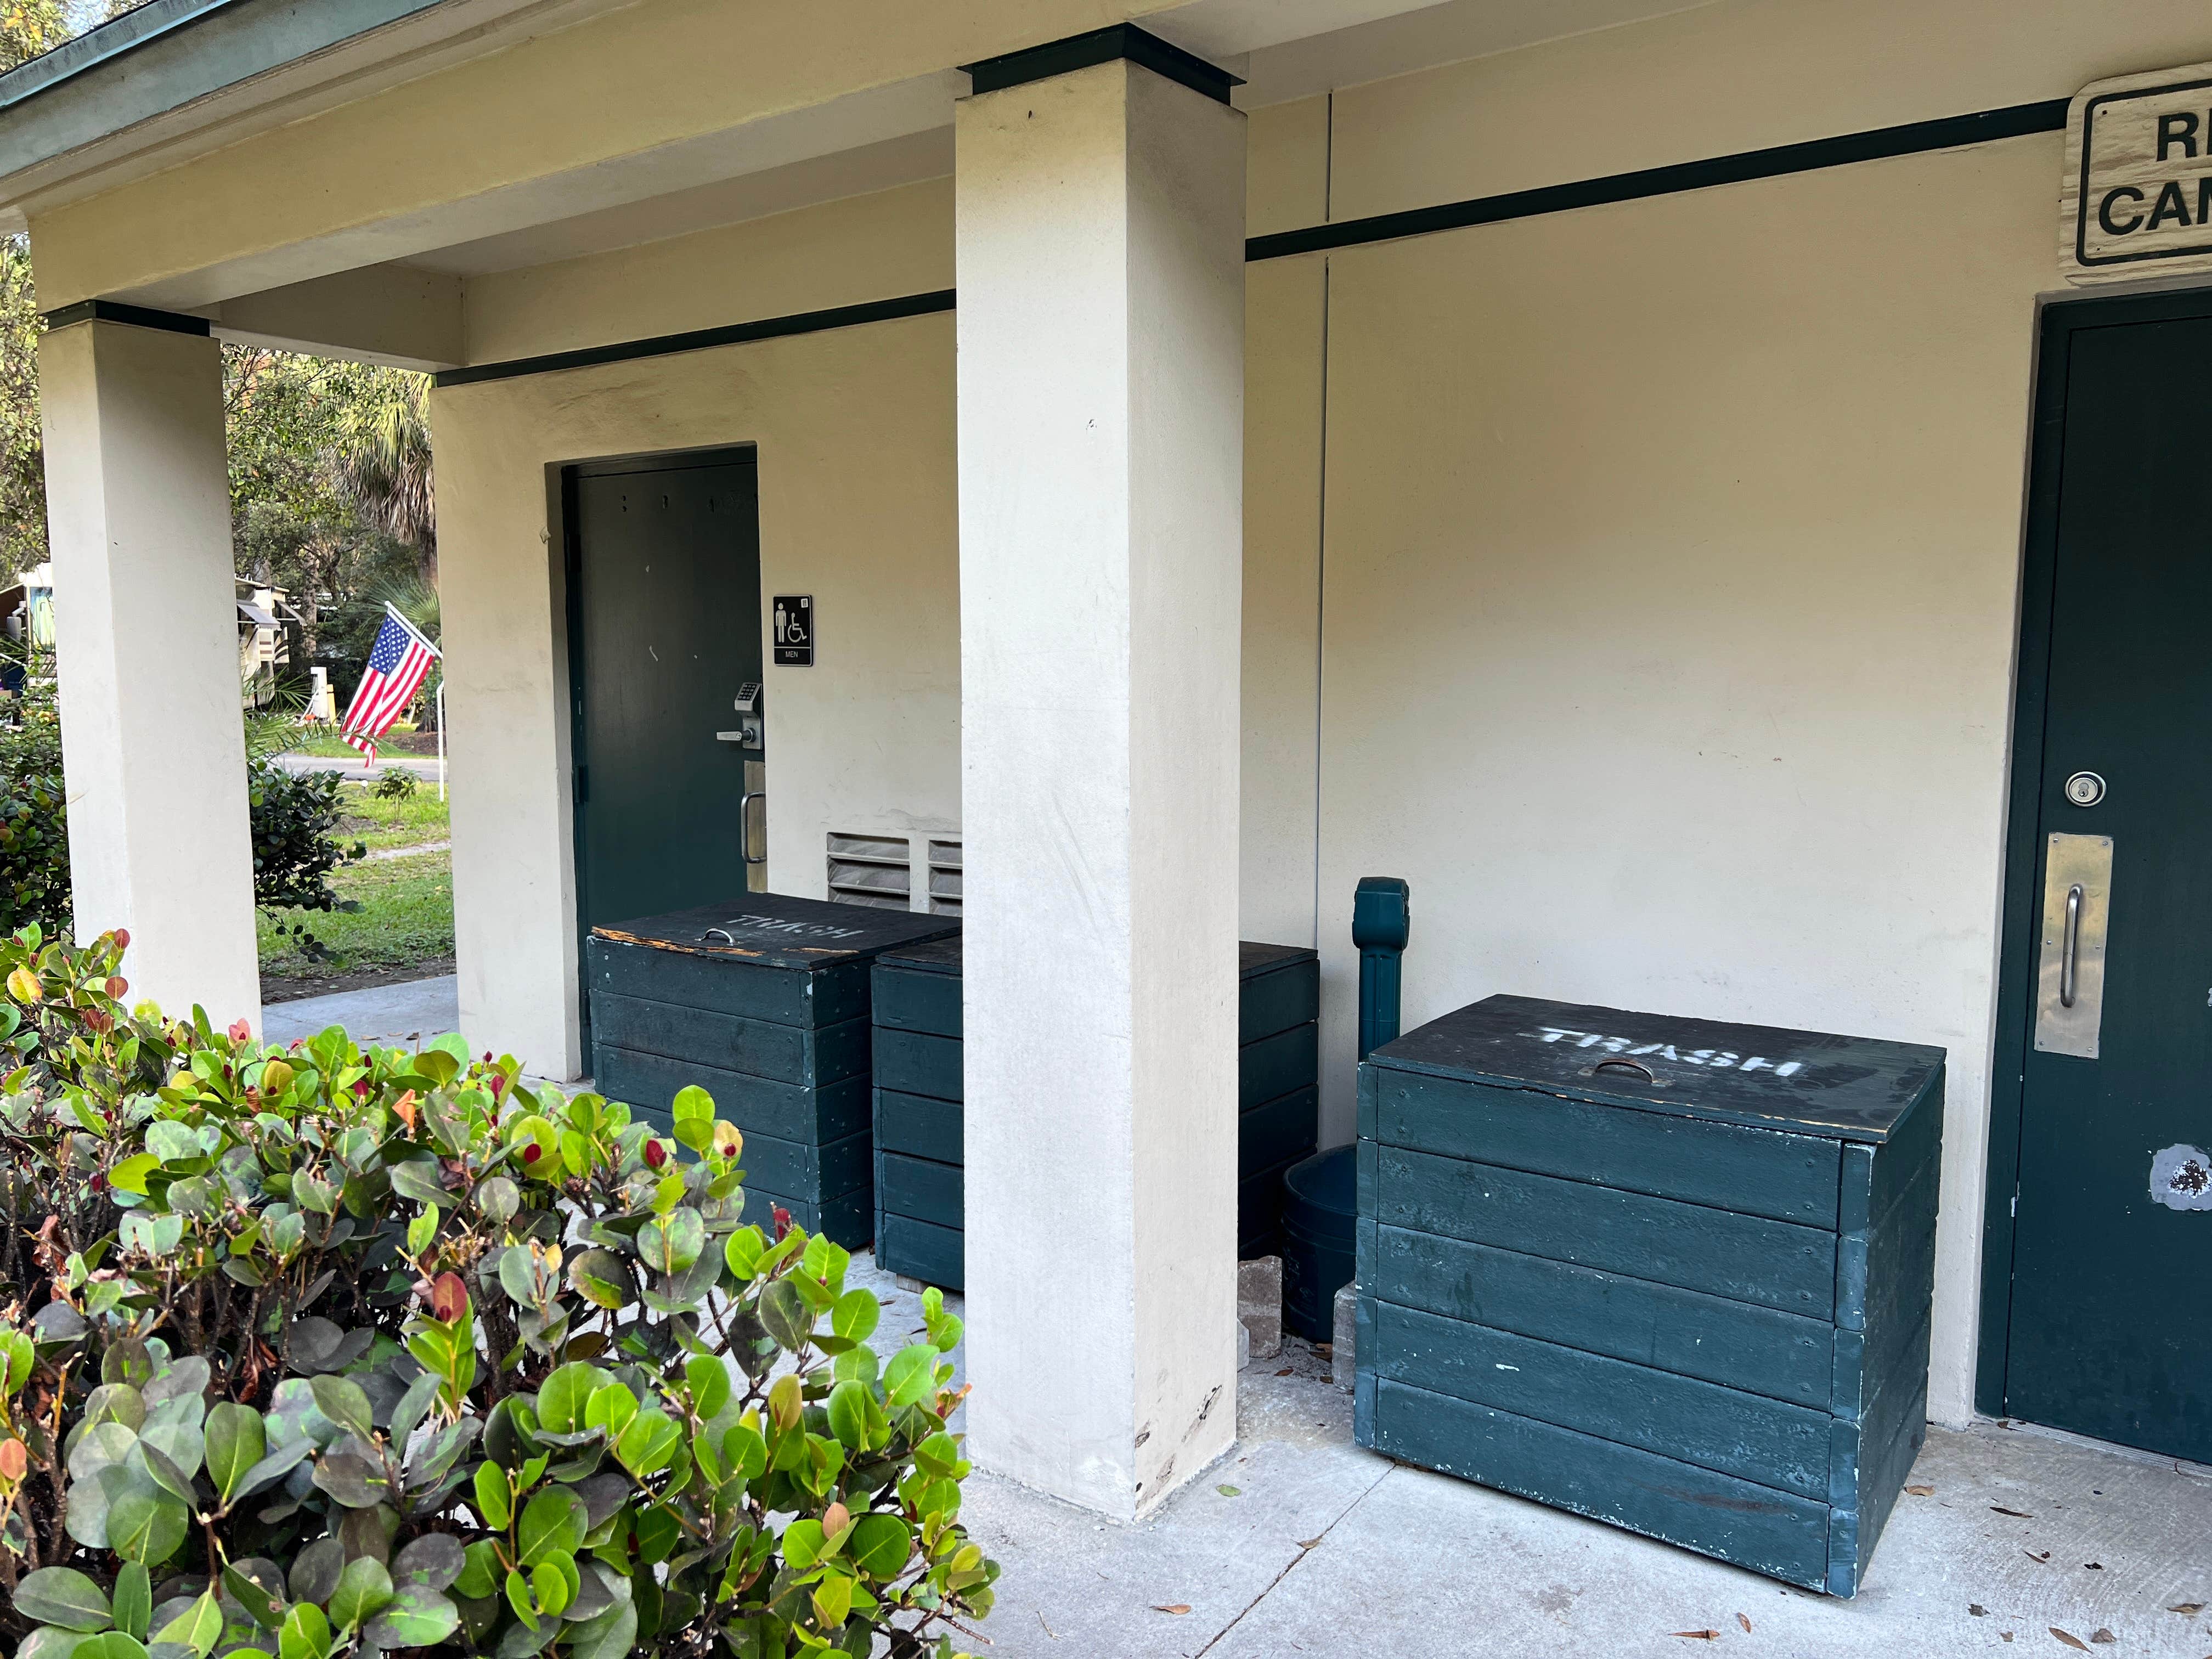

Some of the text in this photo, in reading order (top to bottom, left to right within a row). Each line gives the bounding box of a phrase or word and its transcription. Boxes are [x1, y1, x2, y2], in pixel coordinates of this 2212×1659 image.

[2157, 108, 2212, 161] R
[726, 915, 865, 939] TRASH
[1539, 1027, 1802, 1077] TRASH
